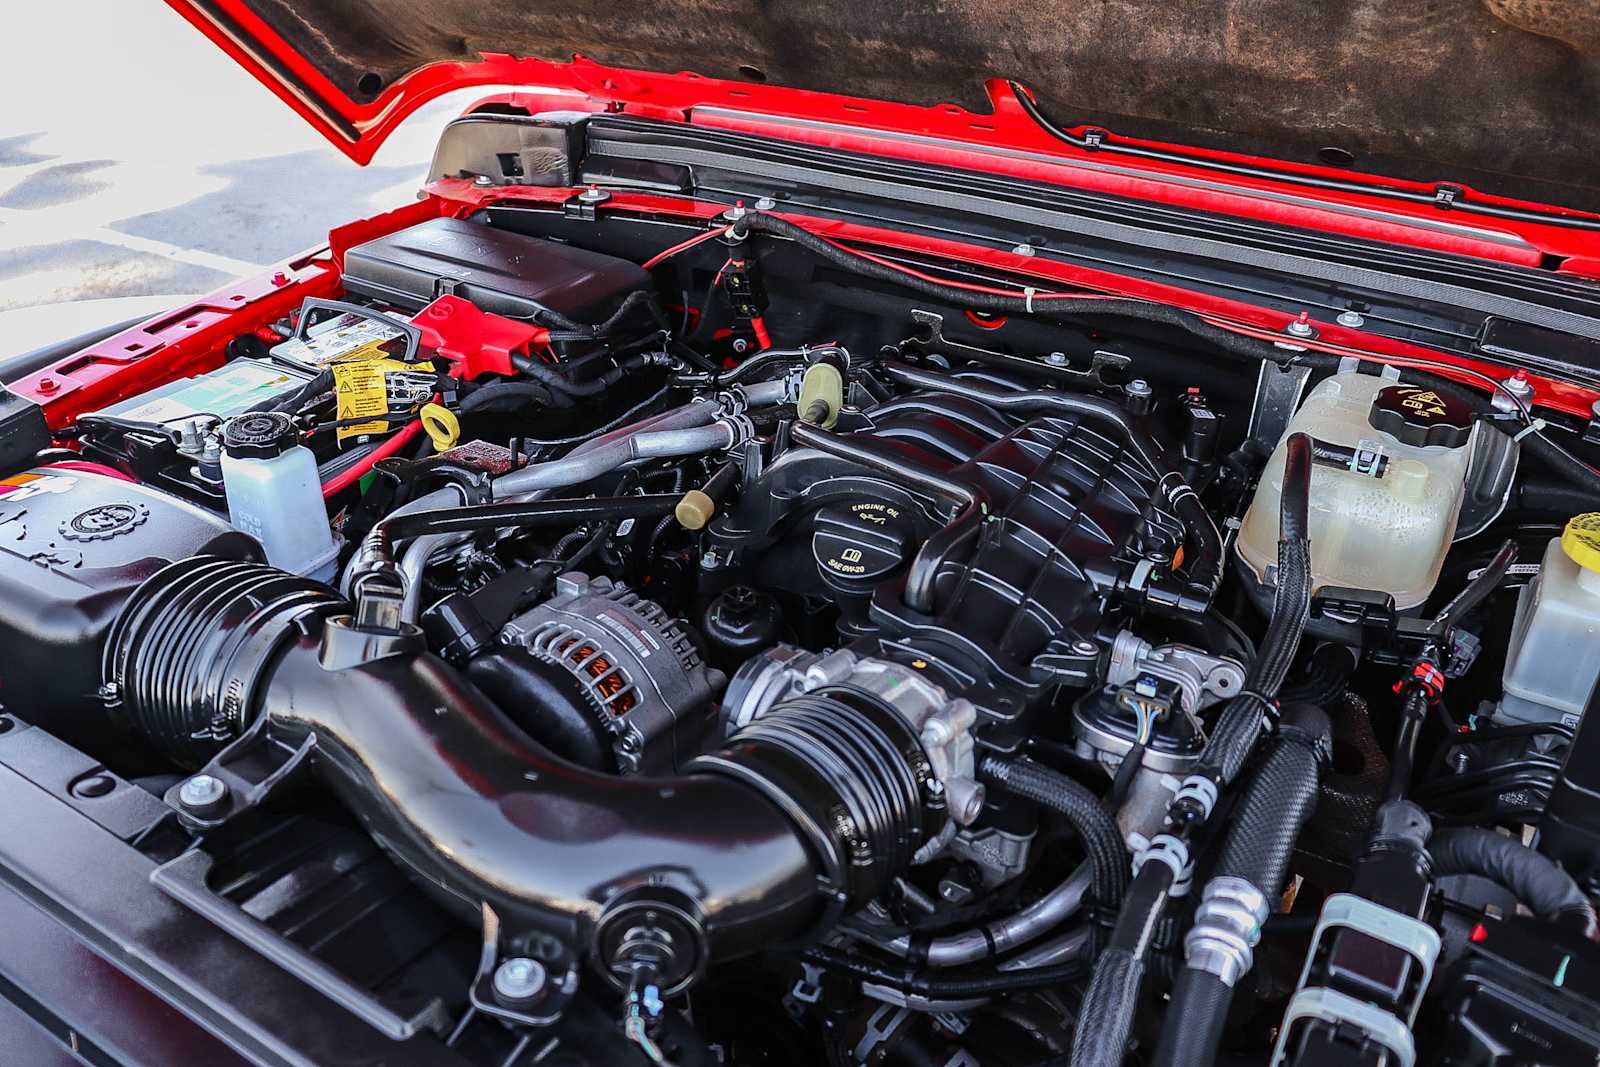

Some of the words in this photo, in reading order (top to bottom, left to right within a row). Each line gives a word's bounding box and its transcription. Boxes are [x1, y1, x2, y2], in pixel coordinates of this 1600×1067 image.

[852, 503, 885, 511] ENGINE
[886, 508, 899, 518] OIL
[828, 559, 843, 570] SAE
